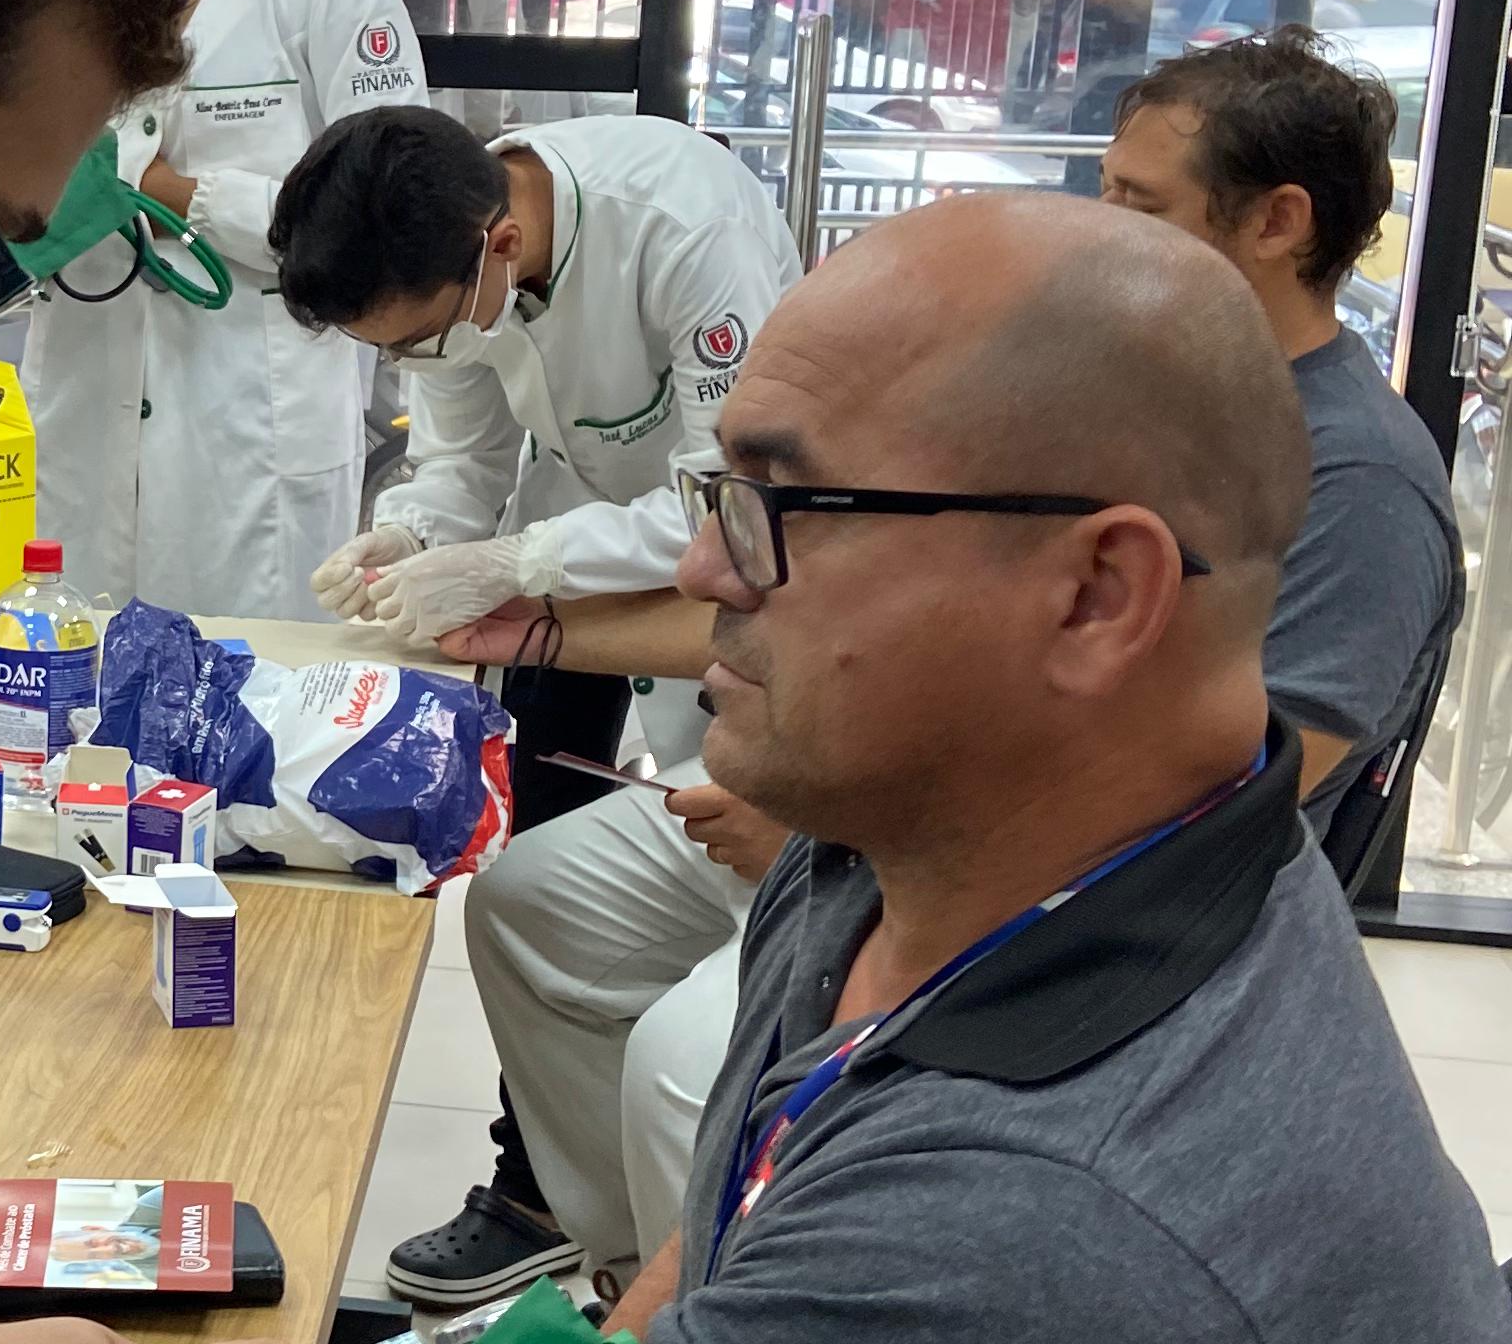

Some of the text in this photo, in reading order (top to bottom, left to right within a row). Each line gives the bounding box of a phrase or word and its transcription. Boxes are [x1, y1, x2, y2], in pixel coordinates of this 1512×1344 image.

[352, 73, 414, 96] FINAMA
[8, 1205, 19, 1217] ao
[20, 1204, 36, 1239] Próstata
[180, 1204, 203, 1256] FINAMA
